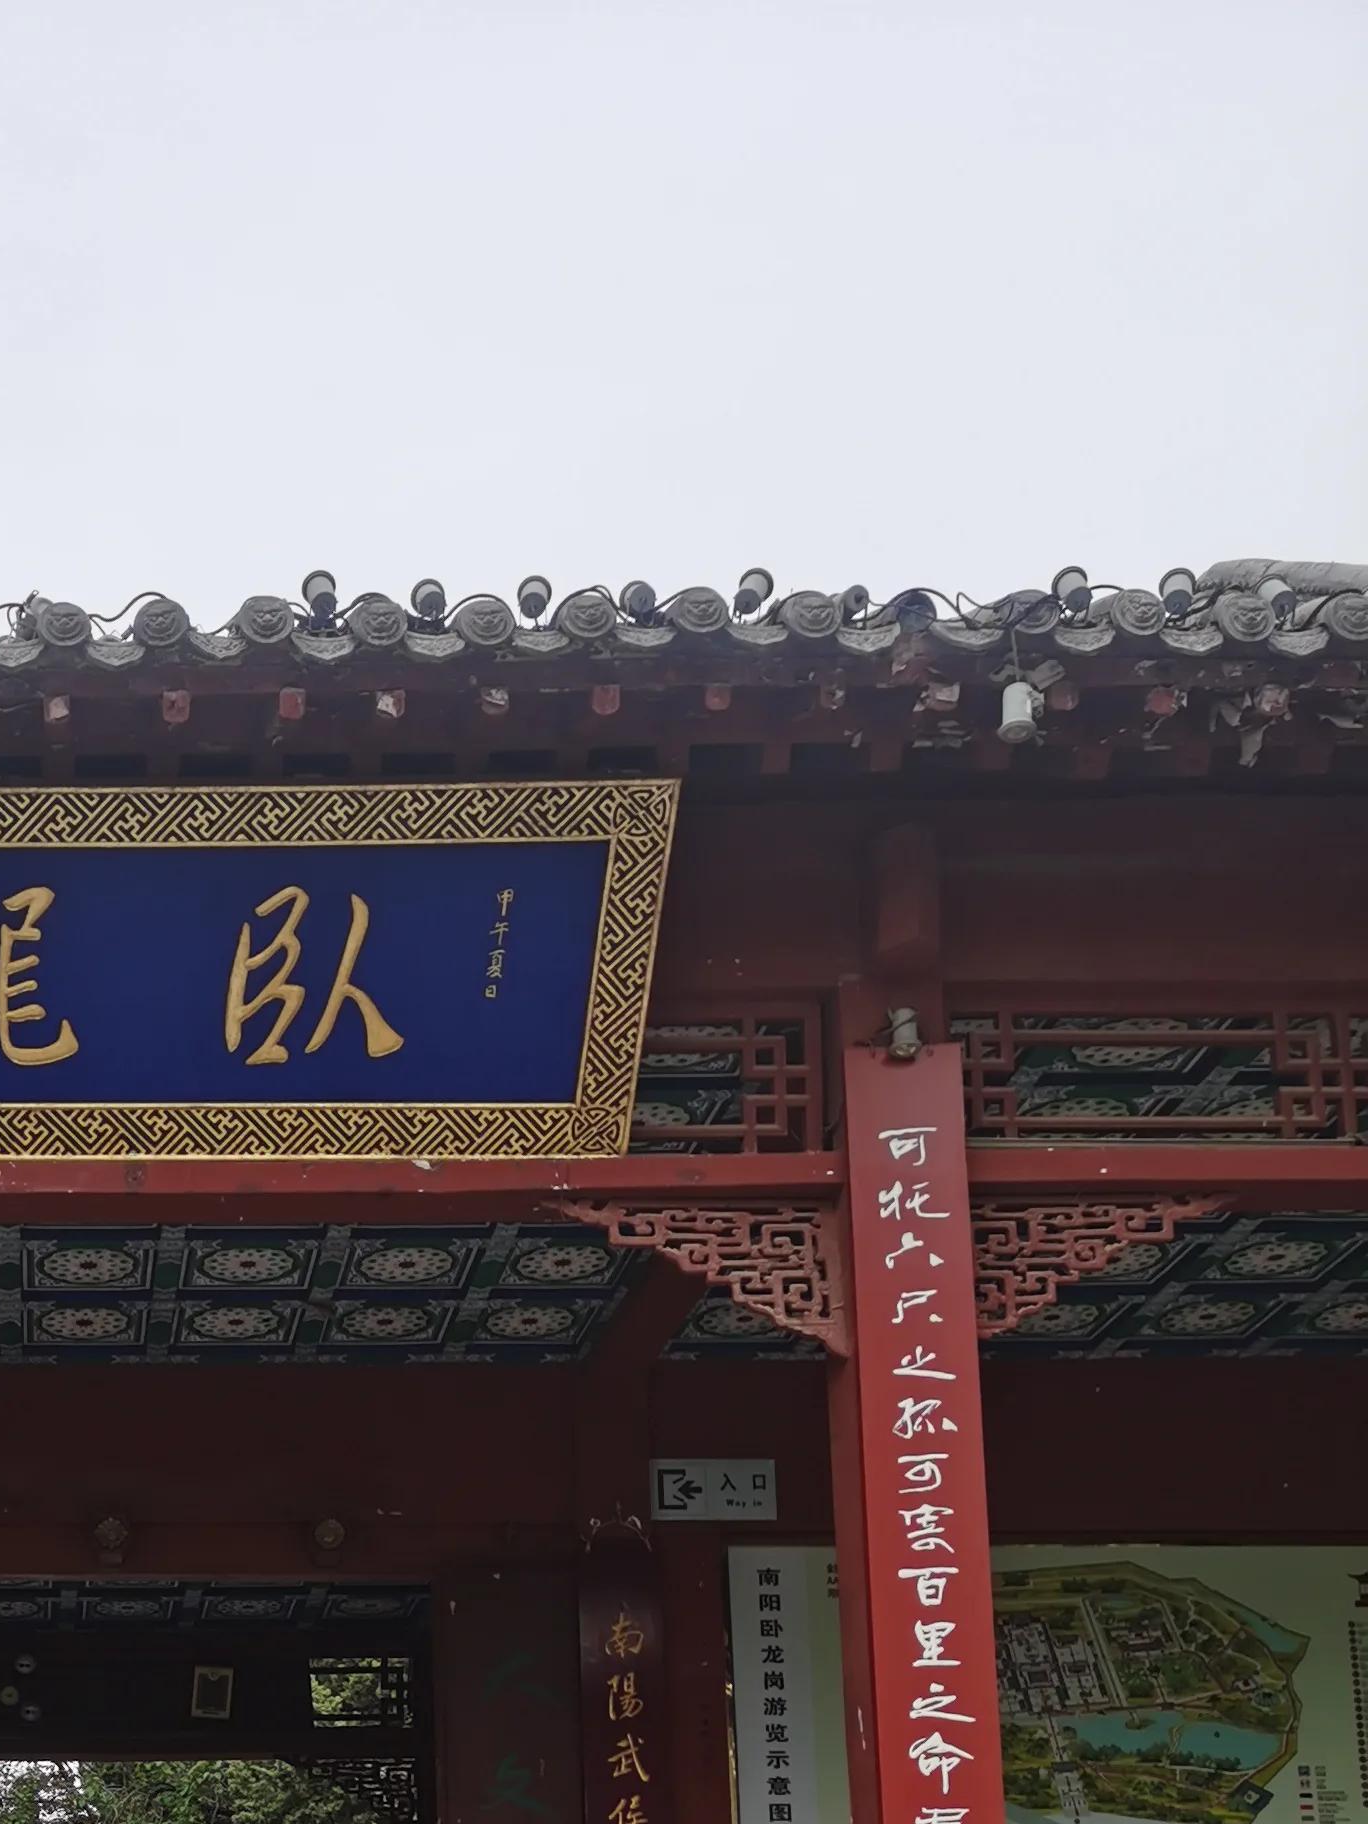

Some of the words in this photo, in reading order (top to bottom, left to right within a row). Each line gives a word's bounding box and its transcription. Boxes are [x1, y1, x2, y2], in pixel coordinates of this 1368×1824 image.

[720, 1472, 767, 1492] 入口
[725, 1498, 747, 1508] Way
[756, 1567, 792, 1822] 南阳卧龙岗游览示意图
